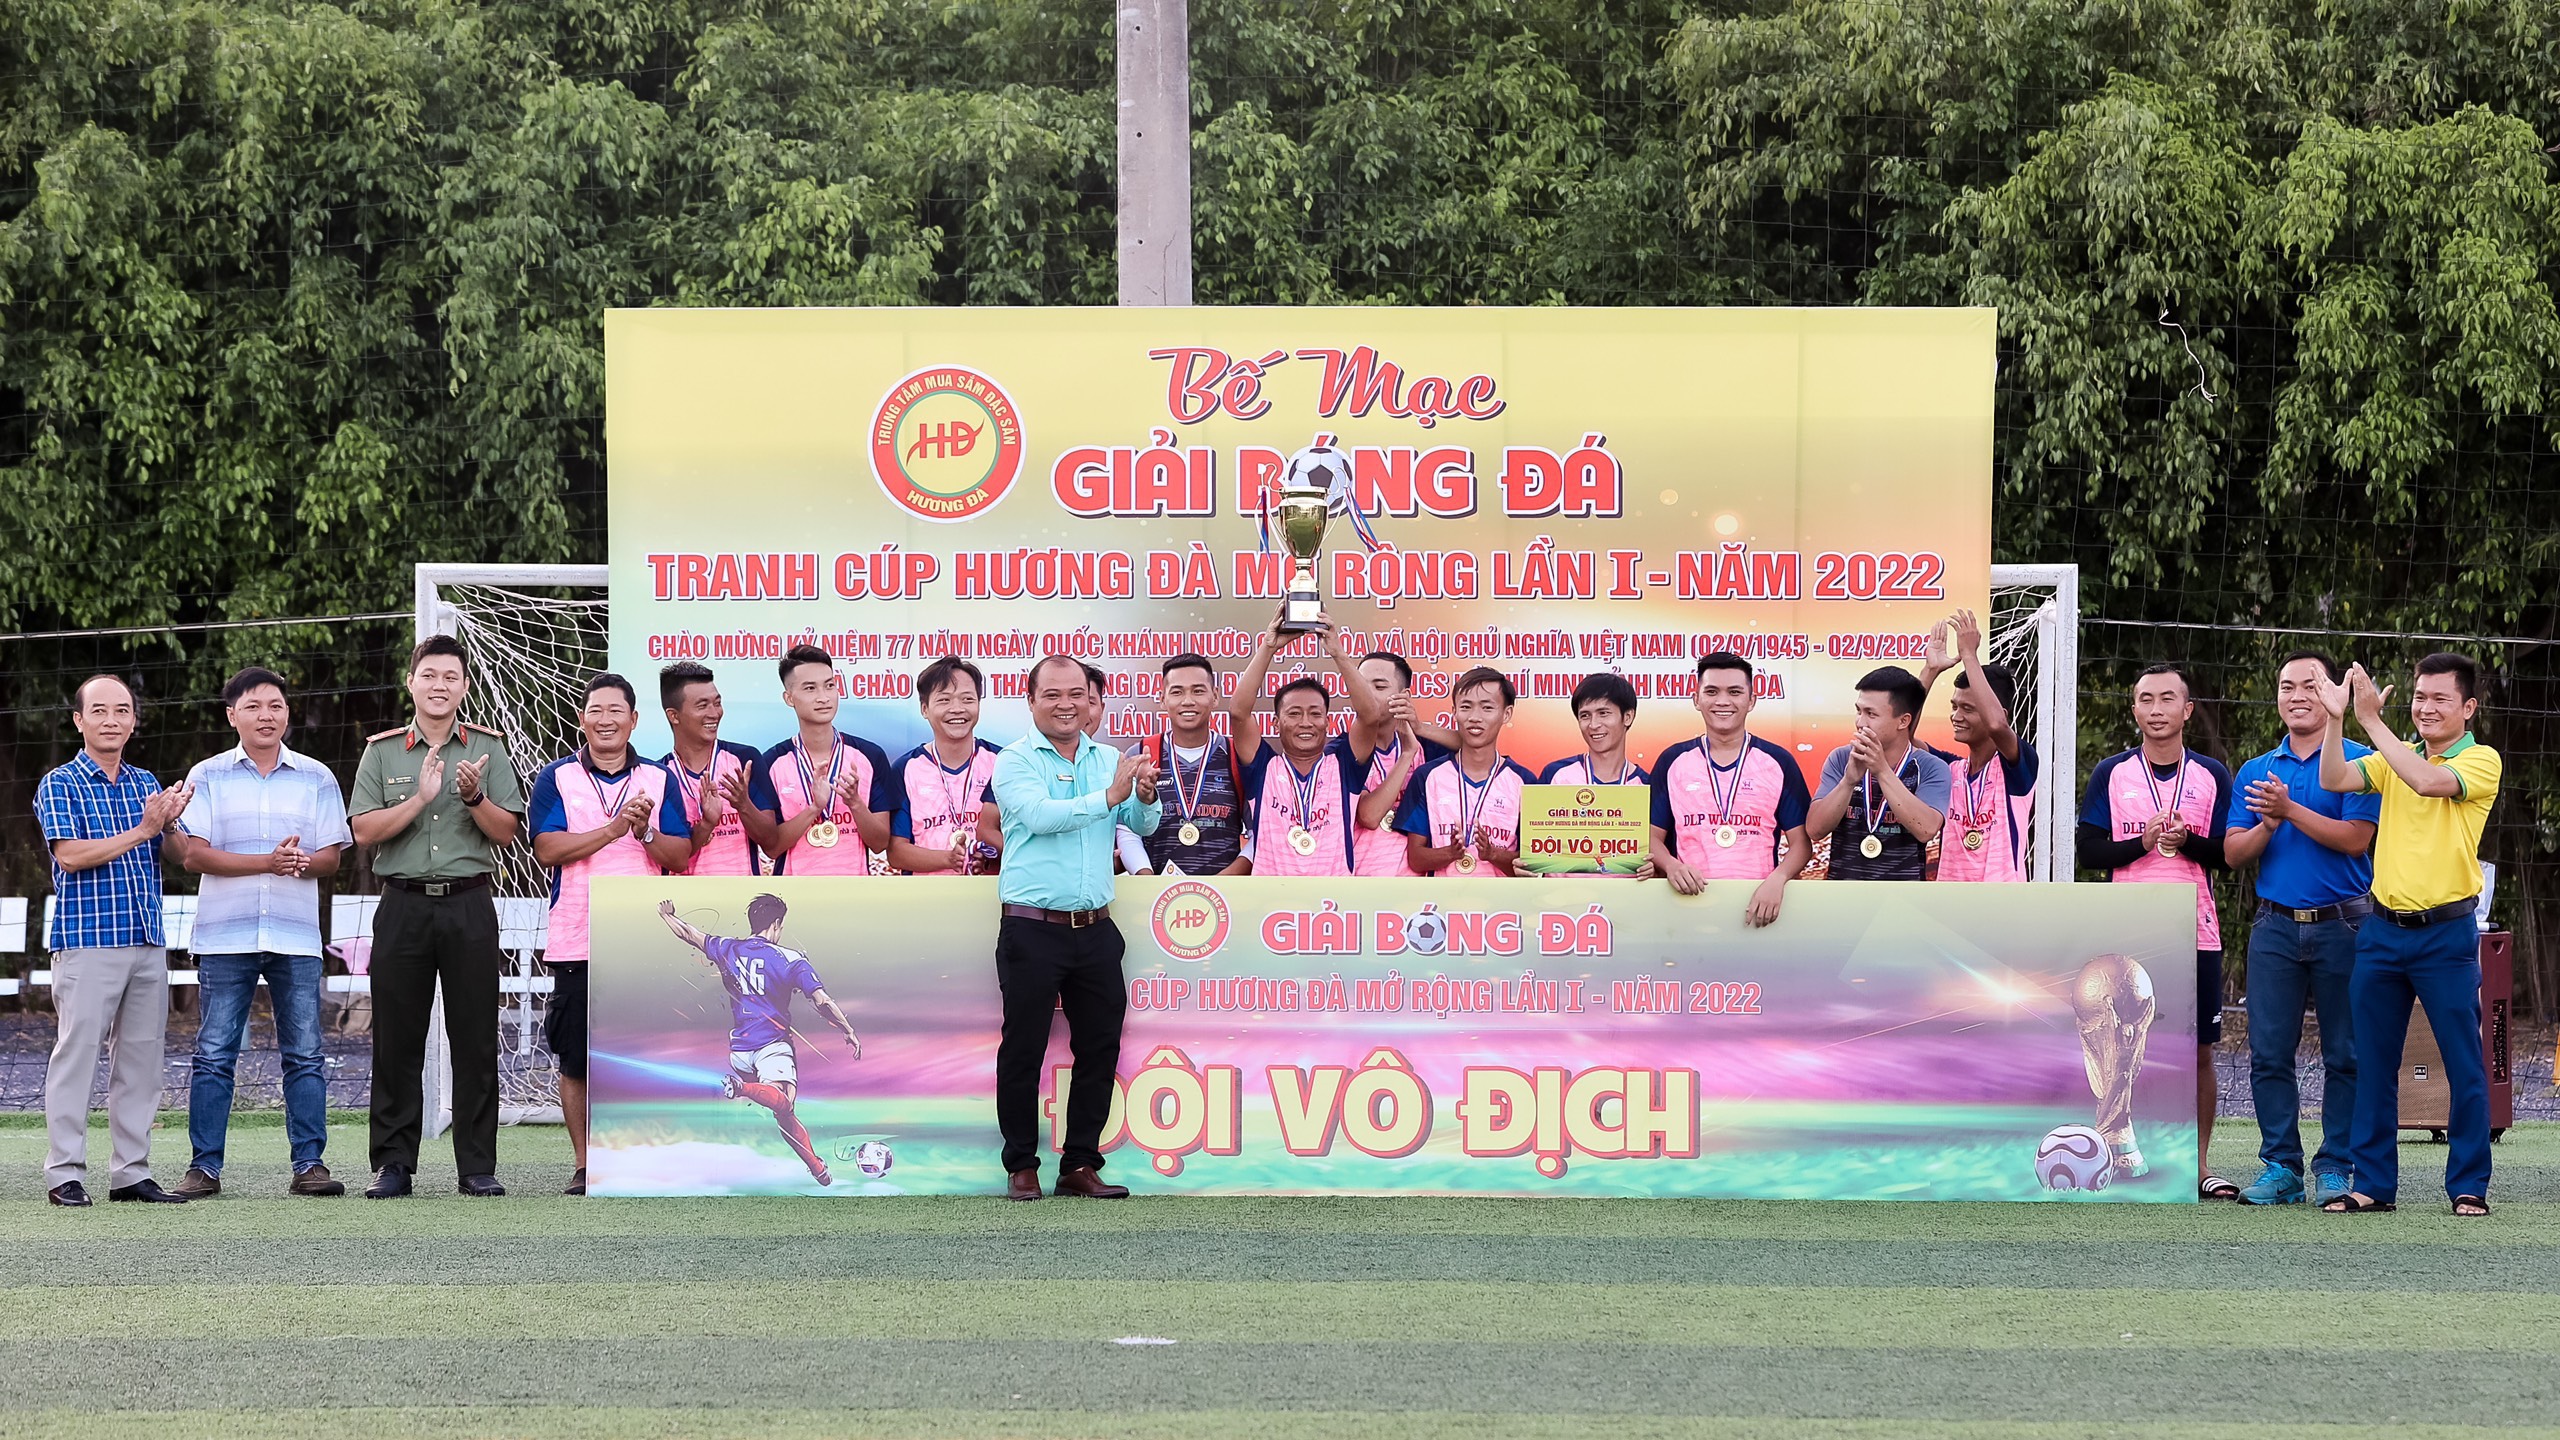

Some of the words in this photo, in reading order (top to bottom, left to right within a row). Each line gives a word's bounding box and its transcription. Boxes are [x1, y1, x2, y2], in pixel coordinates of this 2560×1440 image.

[1149, 347, 1288, 425] Bế
[1296, 345, 1507, 429] Mạc
[877, 403, 901, 446] TRUNG
[895, 381, 923, 405] TÂM
[924, 374, 953, 390] MUA
[984, 391, 1008, 417] ĐẶC
[1000, 417, 1019, 445] SẢN
[1050, 425, 1217, 518] GIẢI
[1497, 431, 1623, 518] ĐÁ
[906, 490, 965, 513] HƯƠNG
[965, 487, 989, 508] ĐÀ
[648, 553, 819, 601] TRANH
[833, 543, 941, 602] CÚP
[954, 547, 1134, 600] HƯƠNG
[1145, 541, 1221, 600] ĐÀ
[1332, 541, 1478, 609] RỘNG
[1491, 535, 1594, 600] LẦN
[1607, 549, 1642, 600] I
[1675, 542, 1801, 600] NĂM
[1814, 551, 1944, 601] 2022
[648, 629, 709, 660] CHÀO
[714, 631, 782, 660] MỪNG
[819, 629, 881, 664] NIỆM
[884, 633, 914, 659] 77
[918, 628, 973, 659] NĂM
[976, 629, 1038, 658] NGÀY
[1107, 627, 1186, 658] KHÁNH
[1189, 627, 1252, 659] NƯỚC
[1323, 626, 1370, 659] ÒA
[1372, 627, 1407, 657] XÃ
[1409, 627, 1449, 664] HỘI
[1453, 624, 1500, 659] CHỦ
[1504, 629, 1575, 659] NGHĨA
[1578, 629, 1627, 664] VIỆT
[1631, 633, 1686, 659] NAM
[851, 668, 913, 699] CHÀO
[990, 668, 1029, 699] THÀ
[1136, 672, 1164, 703] ĐẠ
[1534, 672, 1590, 699] MIN
[1656, 668, 1698, 700] KHÁ
[1753, 668, 1785, 700] ÒA
[1107, 704, 1154, 738] LẦN
[923, 814, 946, 830] DLP
[1683, 814, 1706, 827] DLP
[1707, 814, 1762, 827] WINDOW
[2122, 822, 2147, 835] DLP
[1531, 835, 1562, 857] ĐỘI
[1567, 835, 1594, 854] VÔ
[1599, 838, 1639, 858] ĐỊCH
[1179, 884, 1194, 892] MUA
[1260, 899, 1362, 956] GIẢI
[1375, 902, 1523, 956] BÓNG
[1536, 904, 1613, 957] ĐÁ
[1130, 972, 1190, 1012] CÚP
[1197, 976, 1300, 1012] HƯƠNG
[1306, 973, 1348, 1012] ĐÀ
[1354, 968, 1405, 1012] MỞ
[1411, 973, 1493, 1018] RỘNG
[1500, 969, 1559, 1013] LẦN
[1565, 980, 1585, 1013] I
[1612, 974, 1682, 1014] NĂM
[1688, 981, 1763, 1015] 2022
[1265, 1045, 1433, 1157] VÔ
[1456, 1063, 1701, 1178] ĐỊCH
